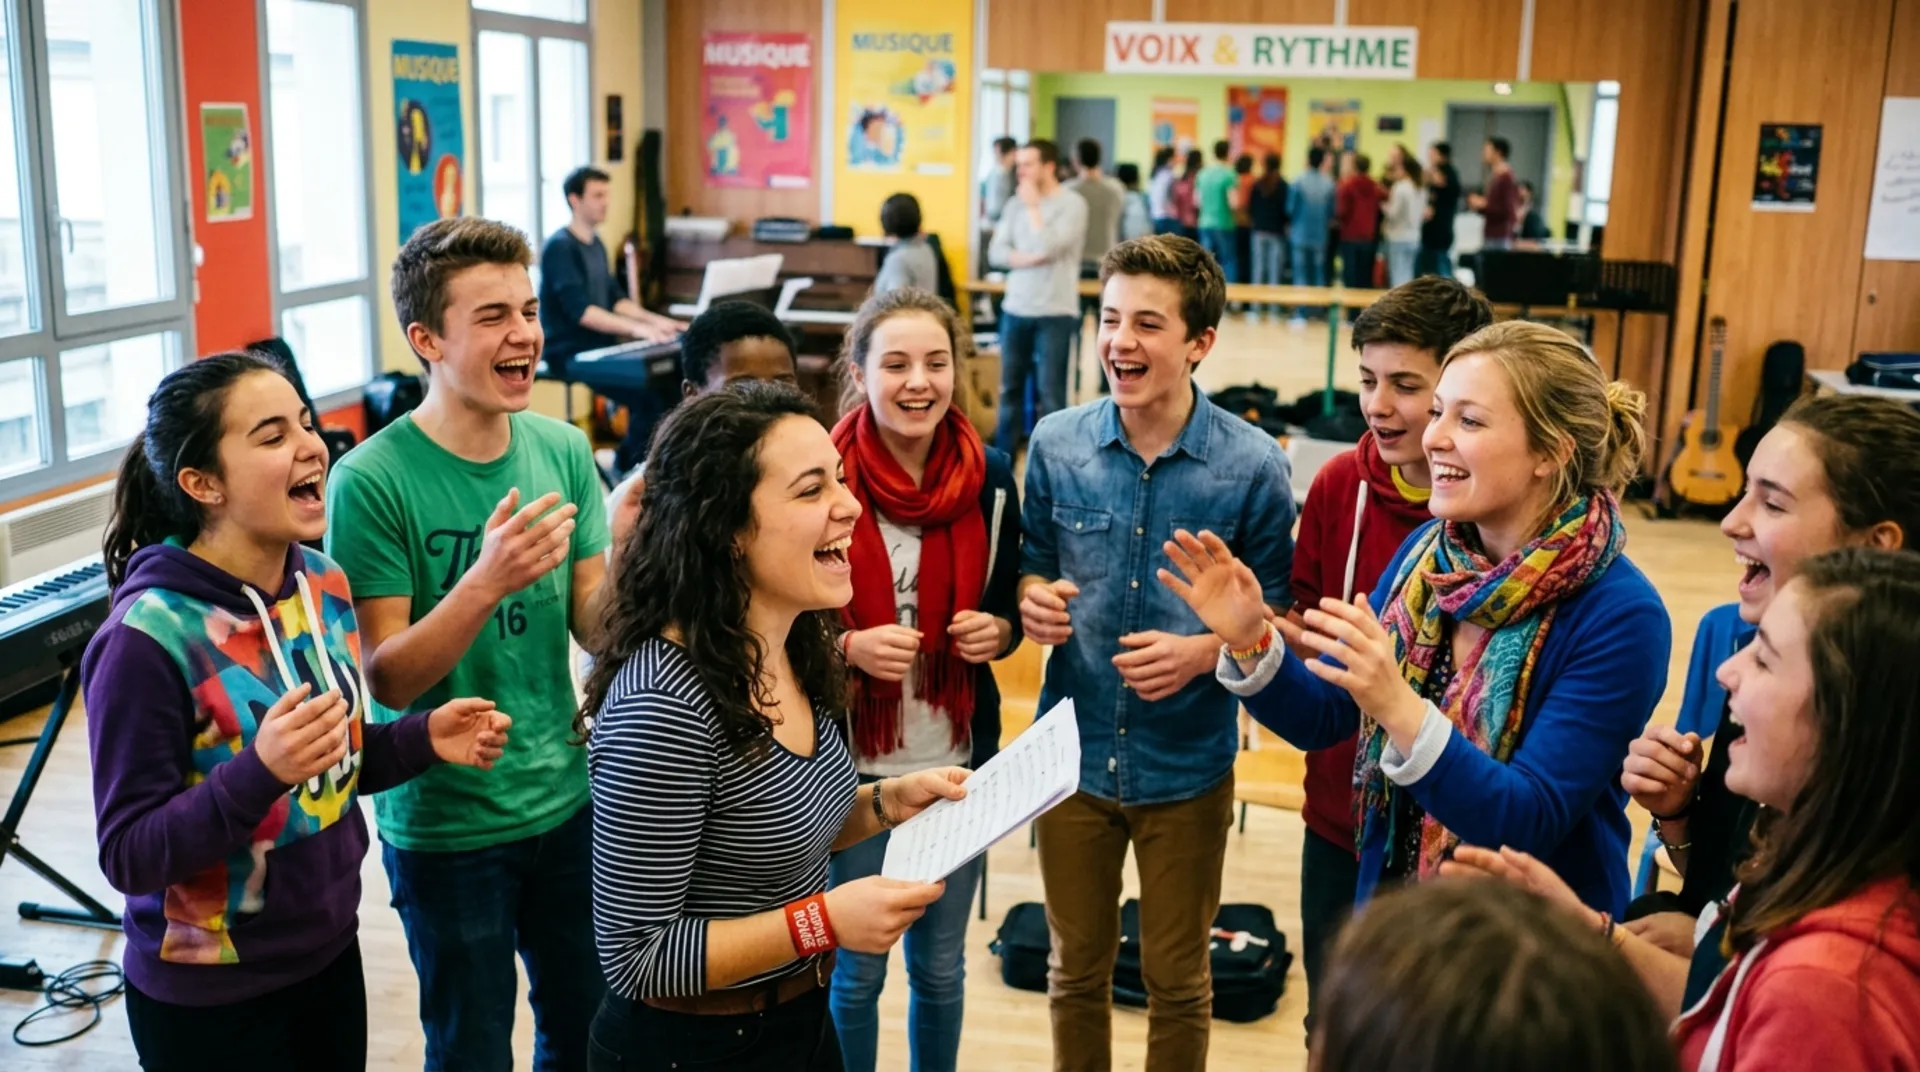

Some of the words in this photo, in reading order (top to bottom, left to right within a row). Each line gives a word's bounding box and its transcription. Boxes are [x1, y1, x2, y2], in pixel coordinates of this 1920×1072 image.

[703, 42, 810, 69] MUSIQUE
[851, 33, 954, 56] MUSIQUE
[1112, 34, 1201, 65] VOIX
[1212, 34, 1239, 65] &
[1254, 36, 1411, 68] RYTHME
[393, 55, 460, 85] MUSIQUE
[494, 601, 527, 640] 16
